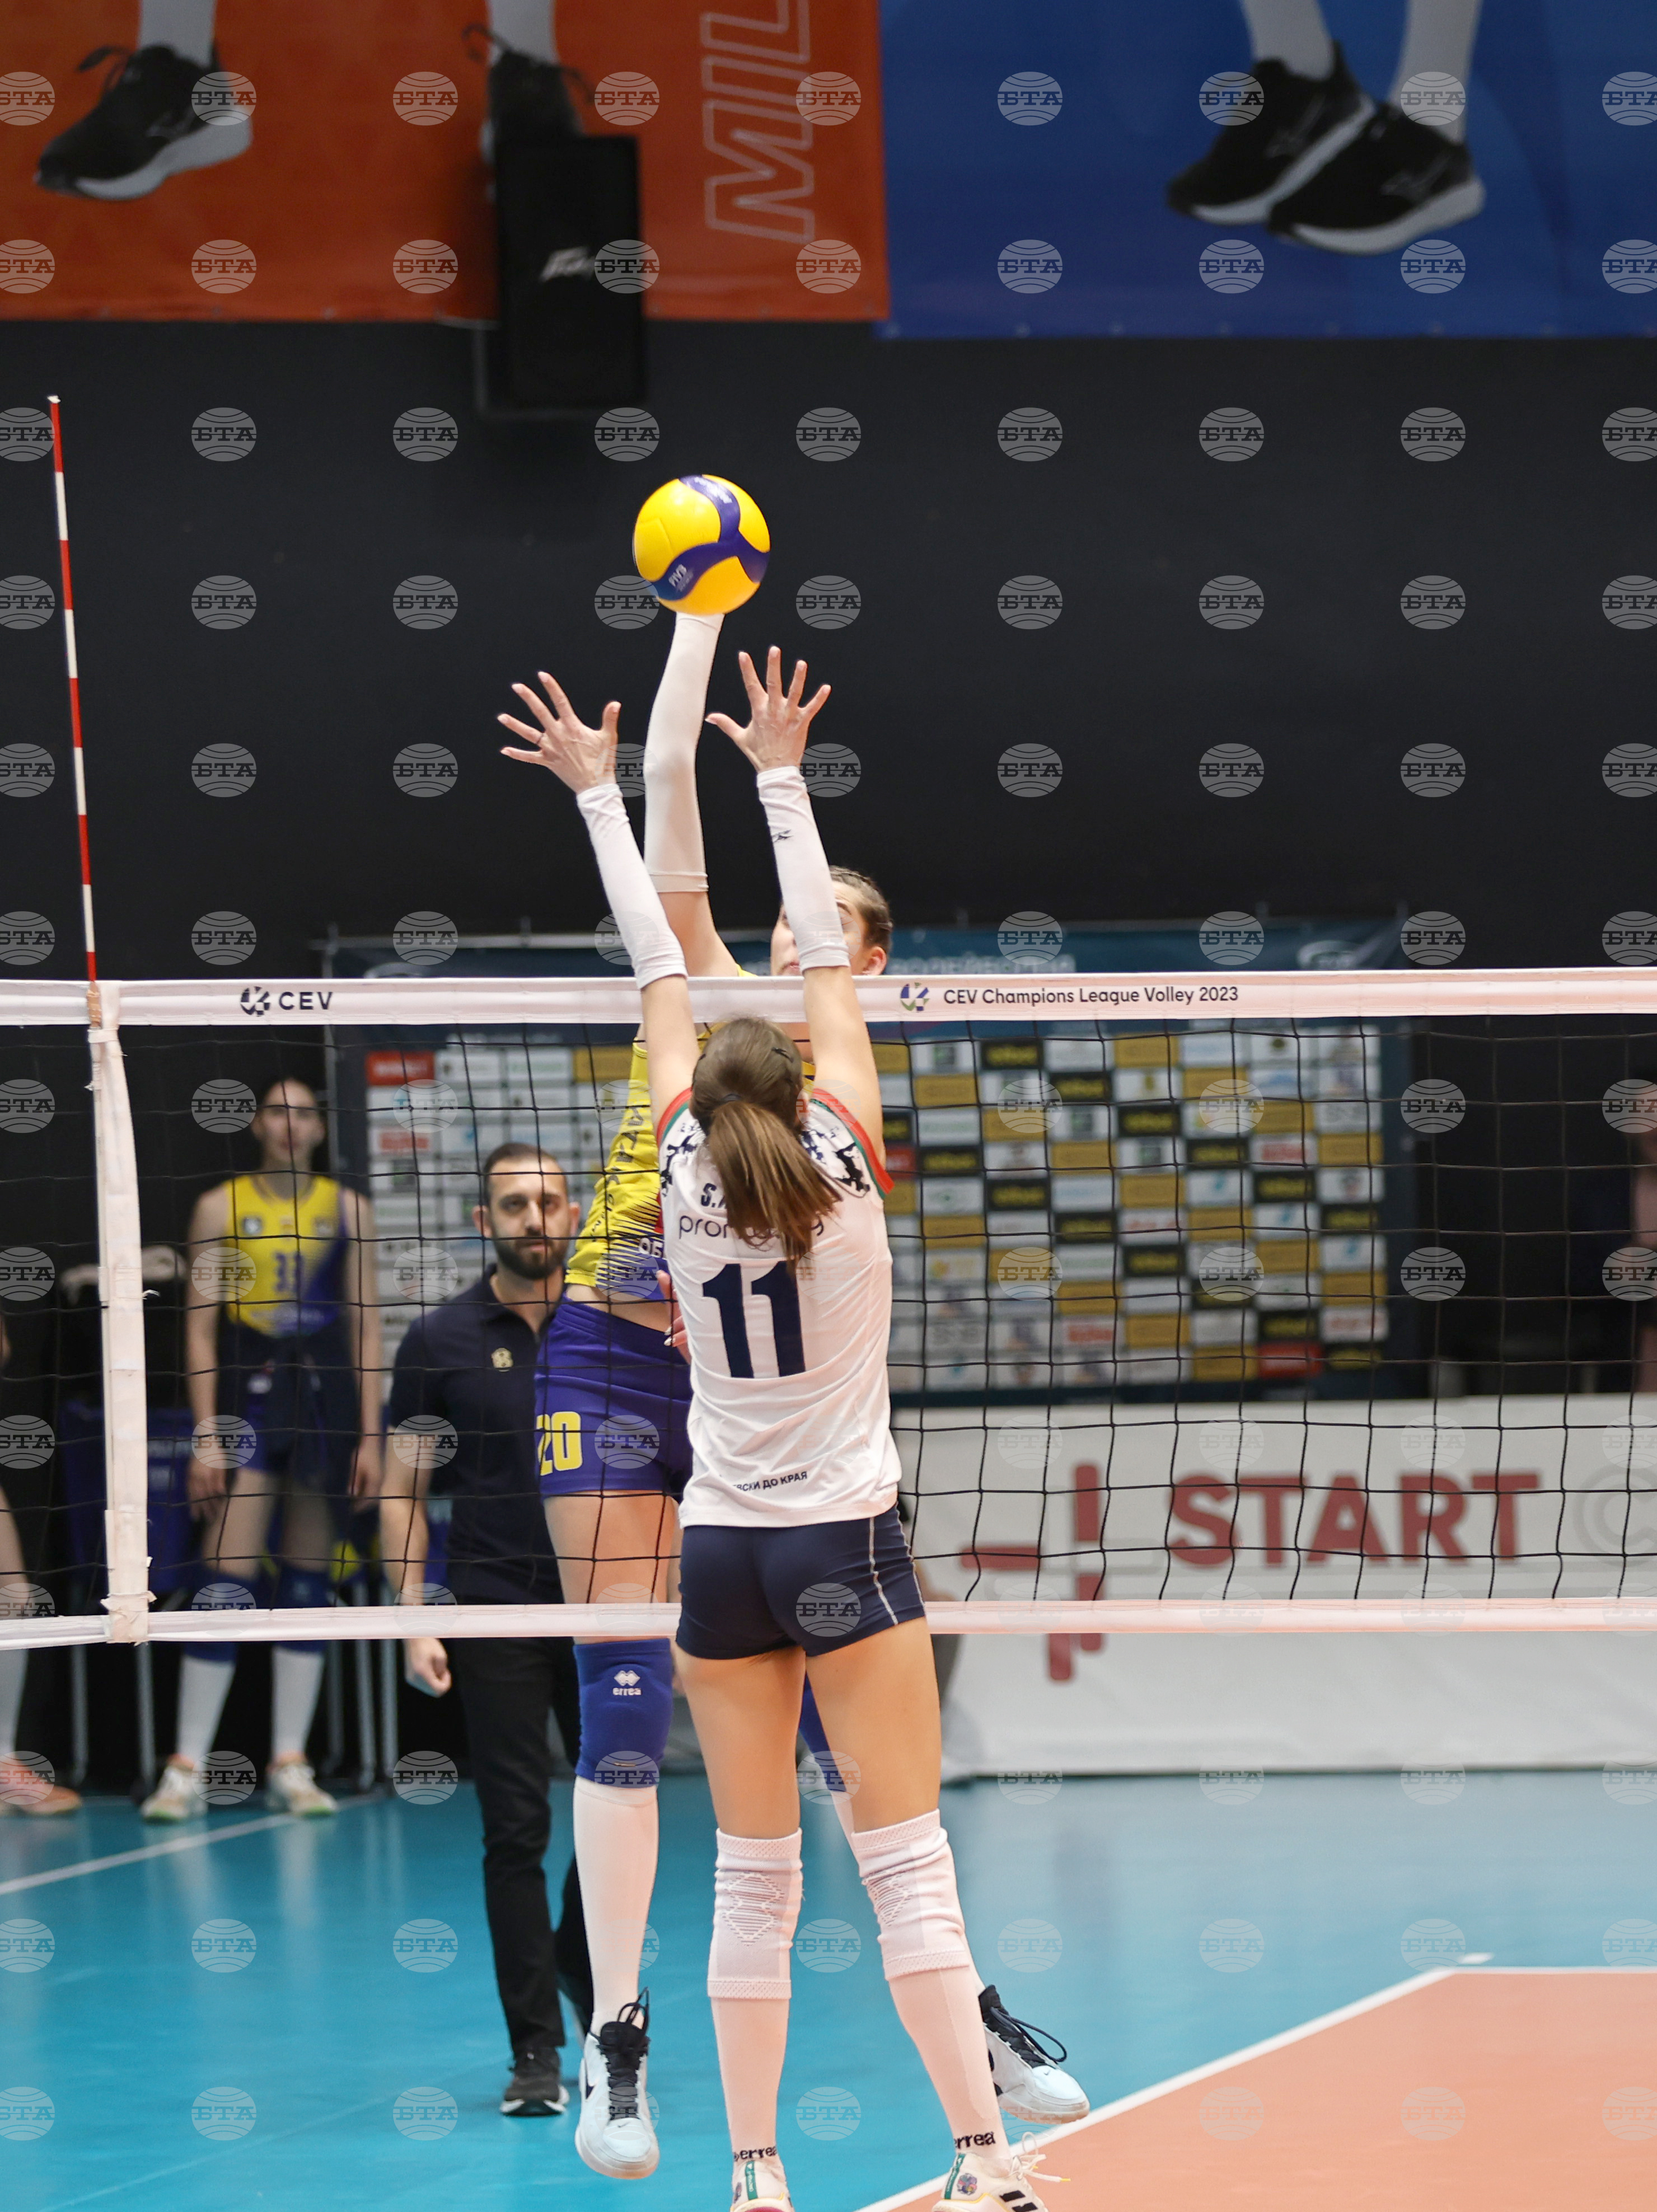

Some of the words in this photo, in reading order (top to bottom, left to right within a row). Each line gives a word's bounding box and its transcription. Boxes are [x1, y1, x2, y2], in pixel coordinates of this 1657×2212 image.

[278, 991, 333, 1010] CEV
[944, 989, 977, 1004] CEV
[982, 988, 1074, 1007] Champions
[1079, 988, 1140, 1005] League
[1144, 986, 1194, 1005] Volley
[1199, 986, 1238, 1001] 2023
[703, 1261, 806, 1379] 11
[536, 1411, 583, 1476] 20
[762, 1478, 779, 1489] ДО
[780, 1471, 808, 1485] КРАЯ
[1164, 1471, 1543, 1569] START
